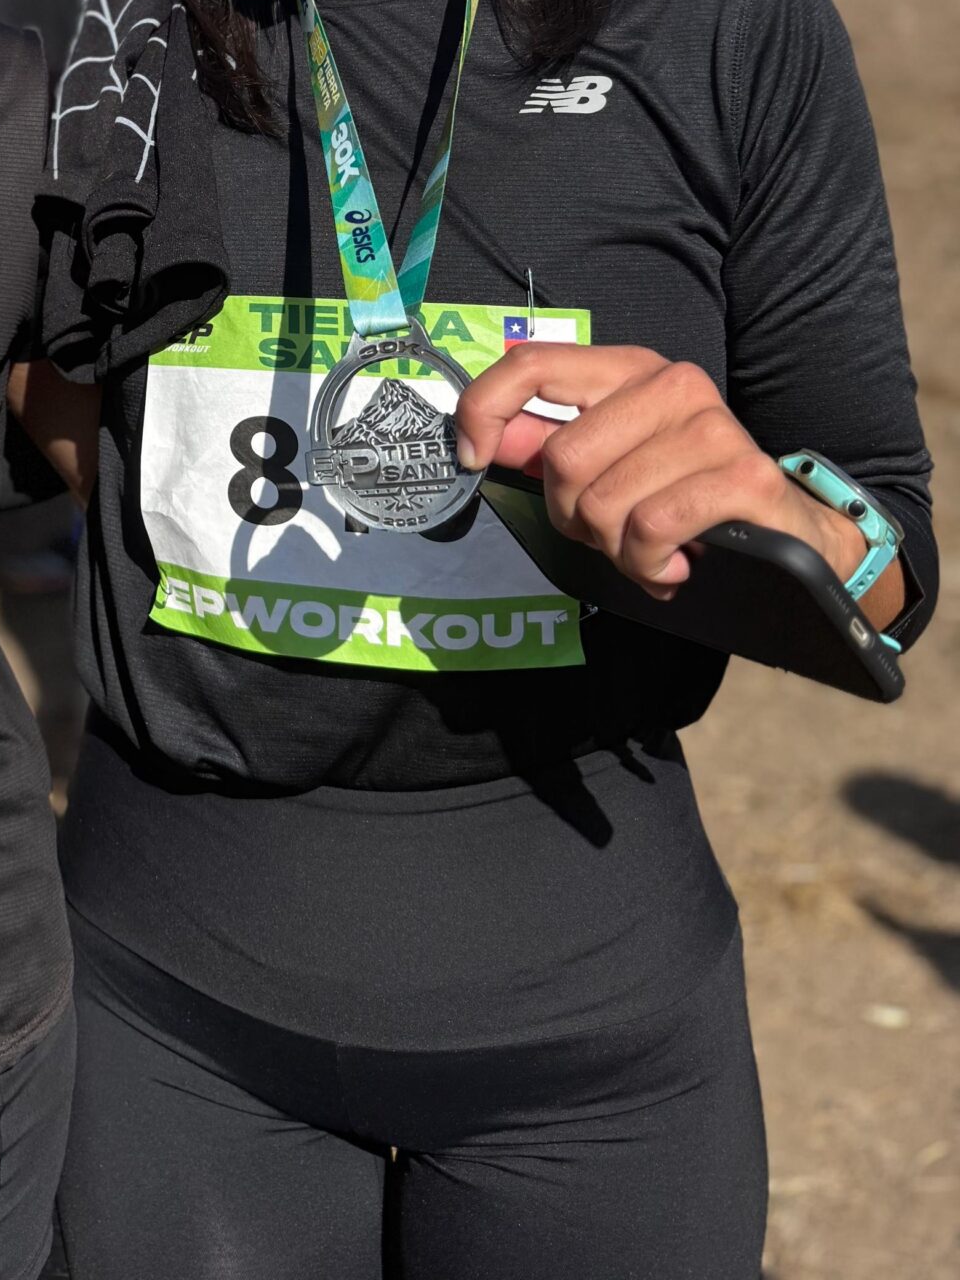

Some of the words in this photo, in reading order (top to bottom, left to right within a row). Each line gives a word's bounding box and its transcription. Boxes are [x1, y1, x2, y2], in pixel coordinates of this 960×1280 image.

[316, 67, 332, 111] SANTA
[324, 55, 340, 106] TIERRA
[331, 121, 360, 188] 30K
[249, 303, 475, 342] TIEA
[179, 323, 214, 344] P
[359, 340, 420, 360] 30K
[380, 440, 457, 461] TIER
[381, 461, 451, 481] SANT
[383, 514, 428, 528] 2025
